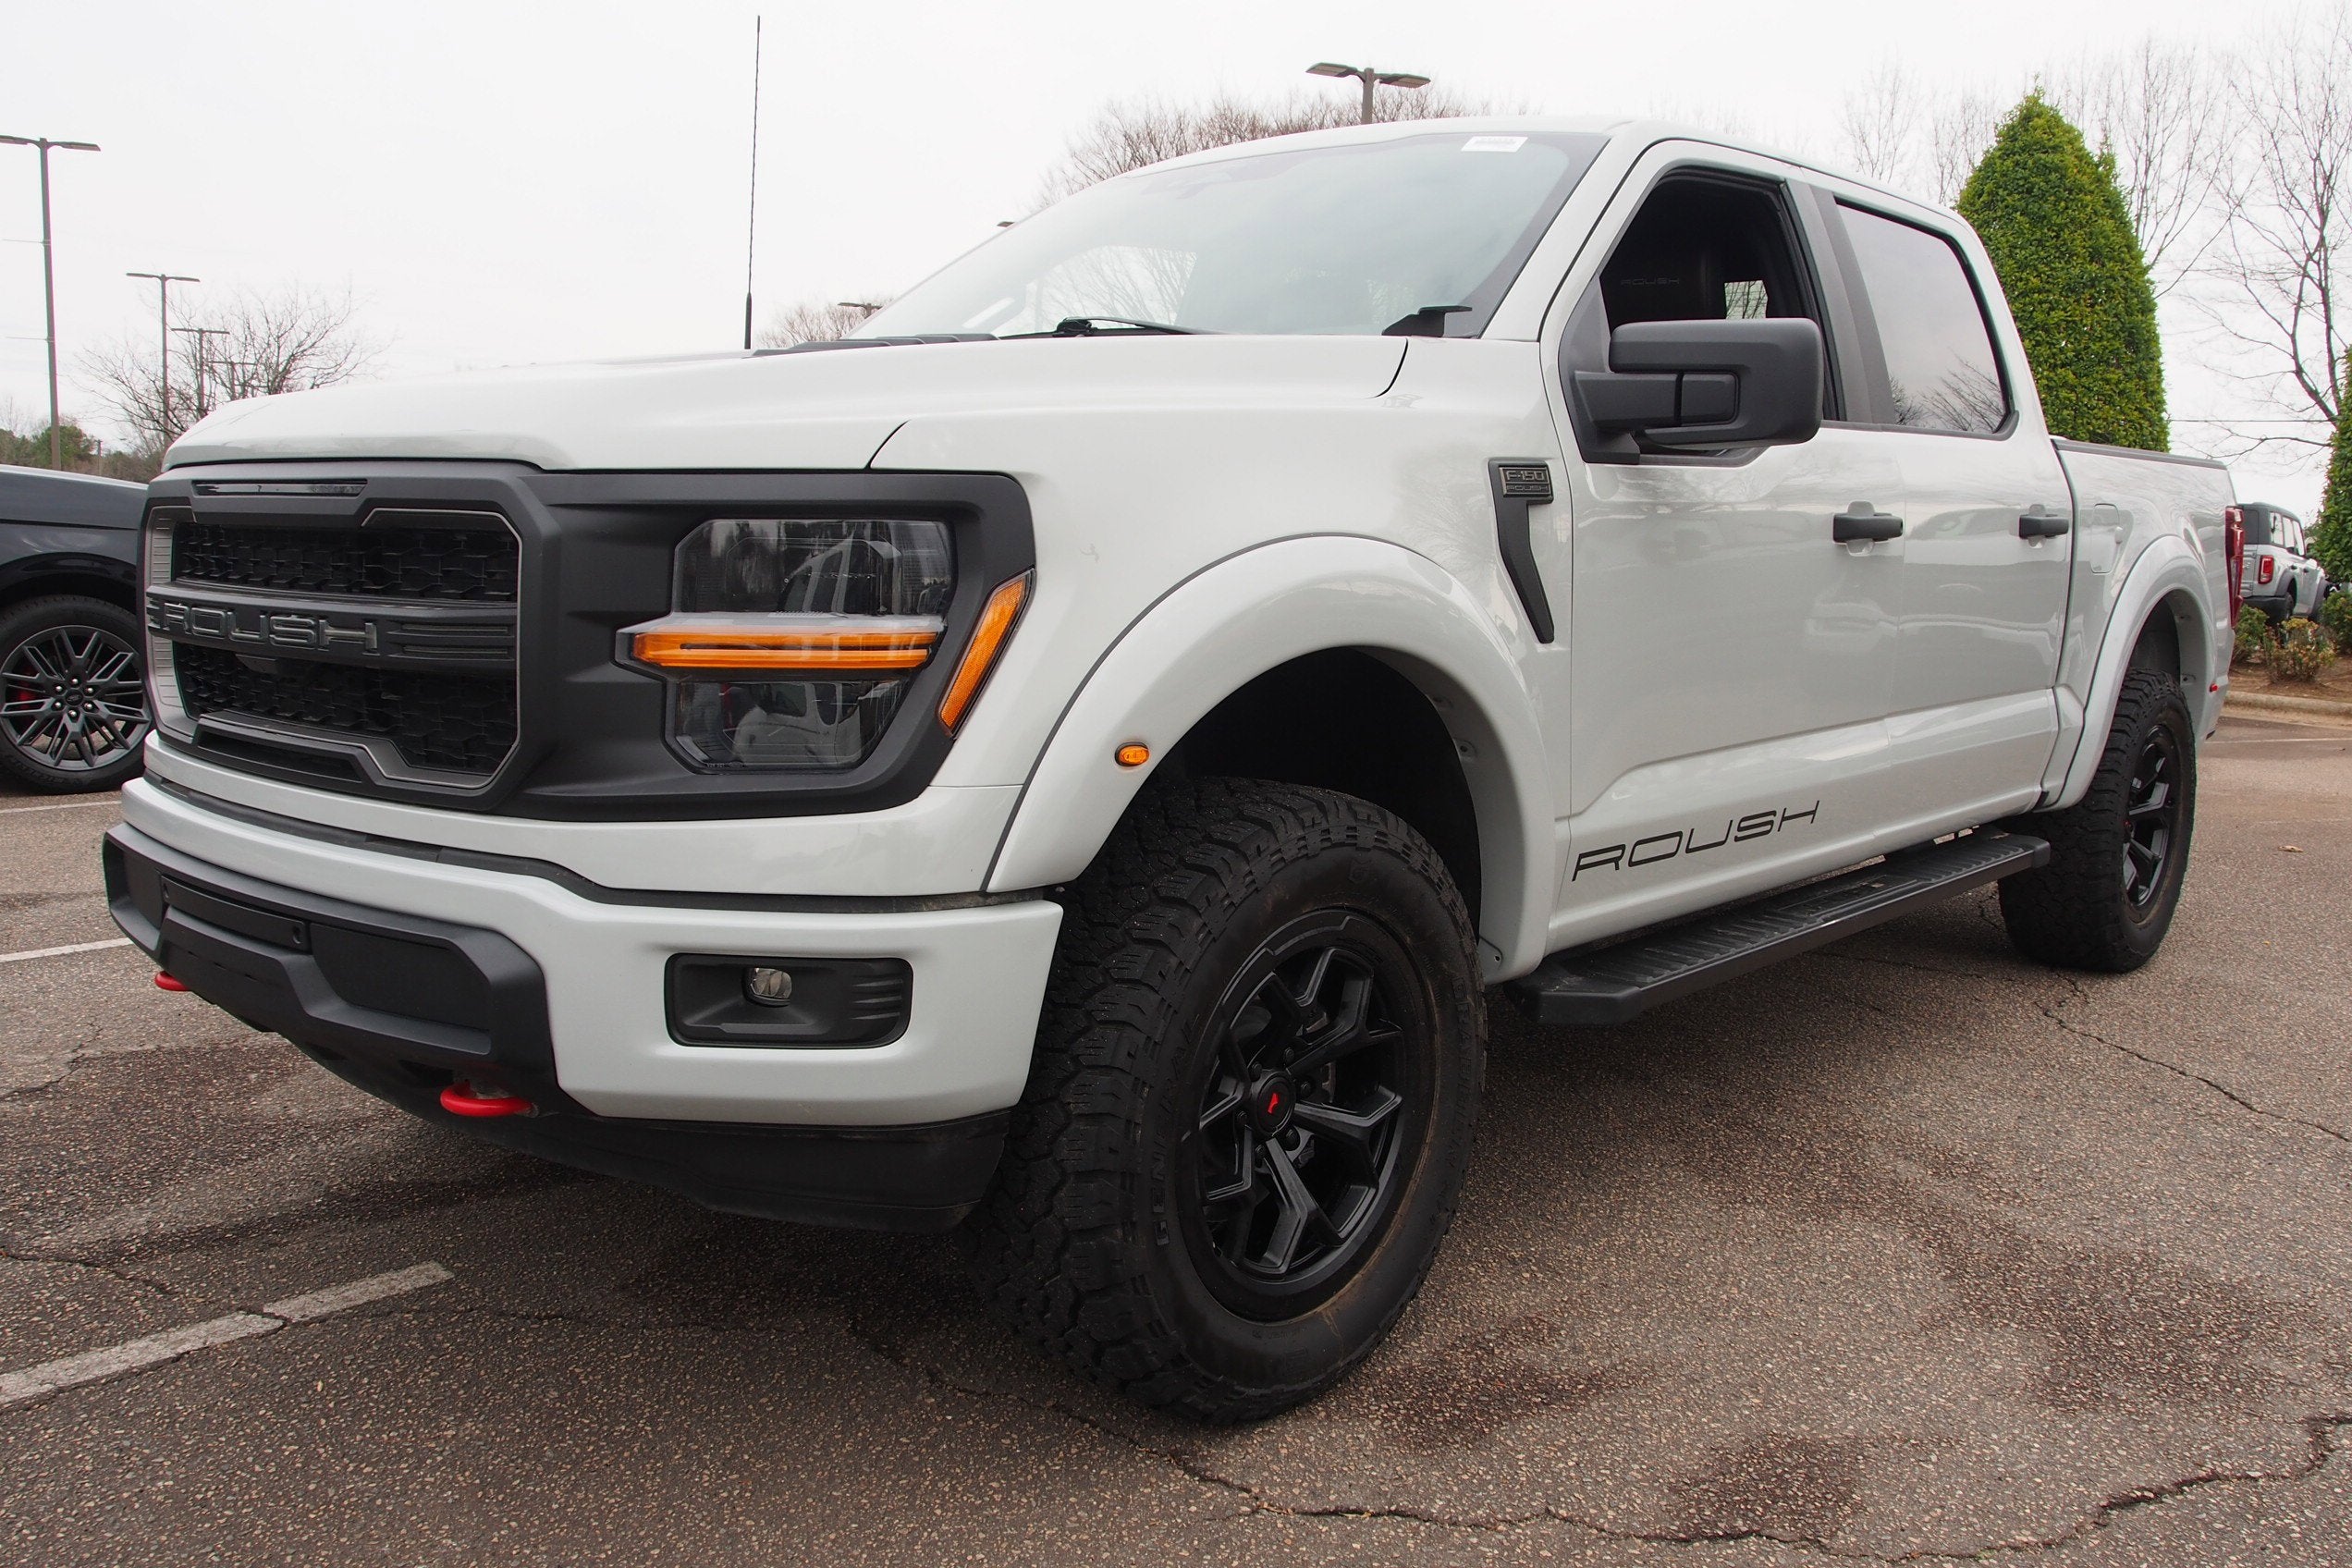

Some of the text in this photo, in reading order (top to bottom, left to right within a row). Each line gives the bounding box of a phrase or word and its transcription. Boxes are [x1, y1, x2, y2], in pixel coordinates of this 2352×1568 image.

[1506, 470, 1545, 481] F-150
[164, 602, 380, 656] ROUSH
[1572, 801, 1819, 882] ROUSH
